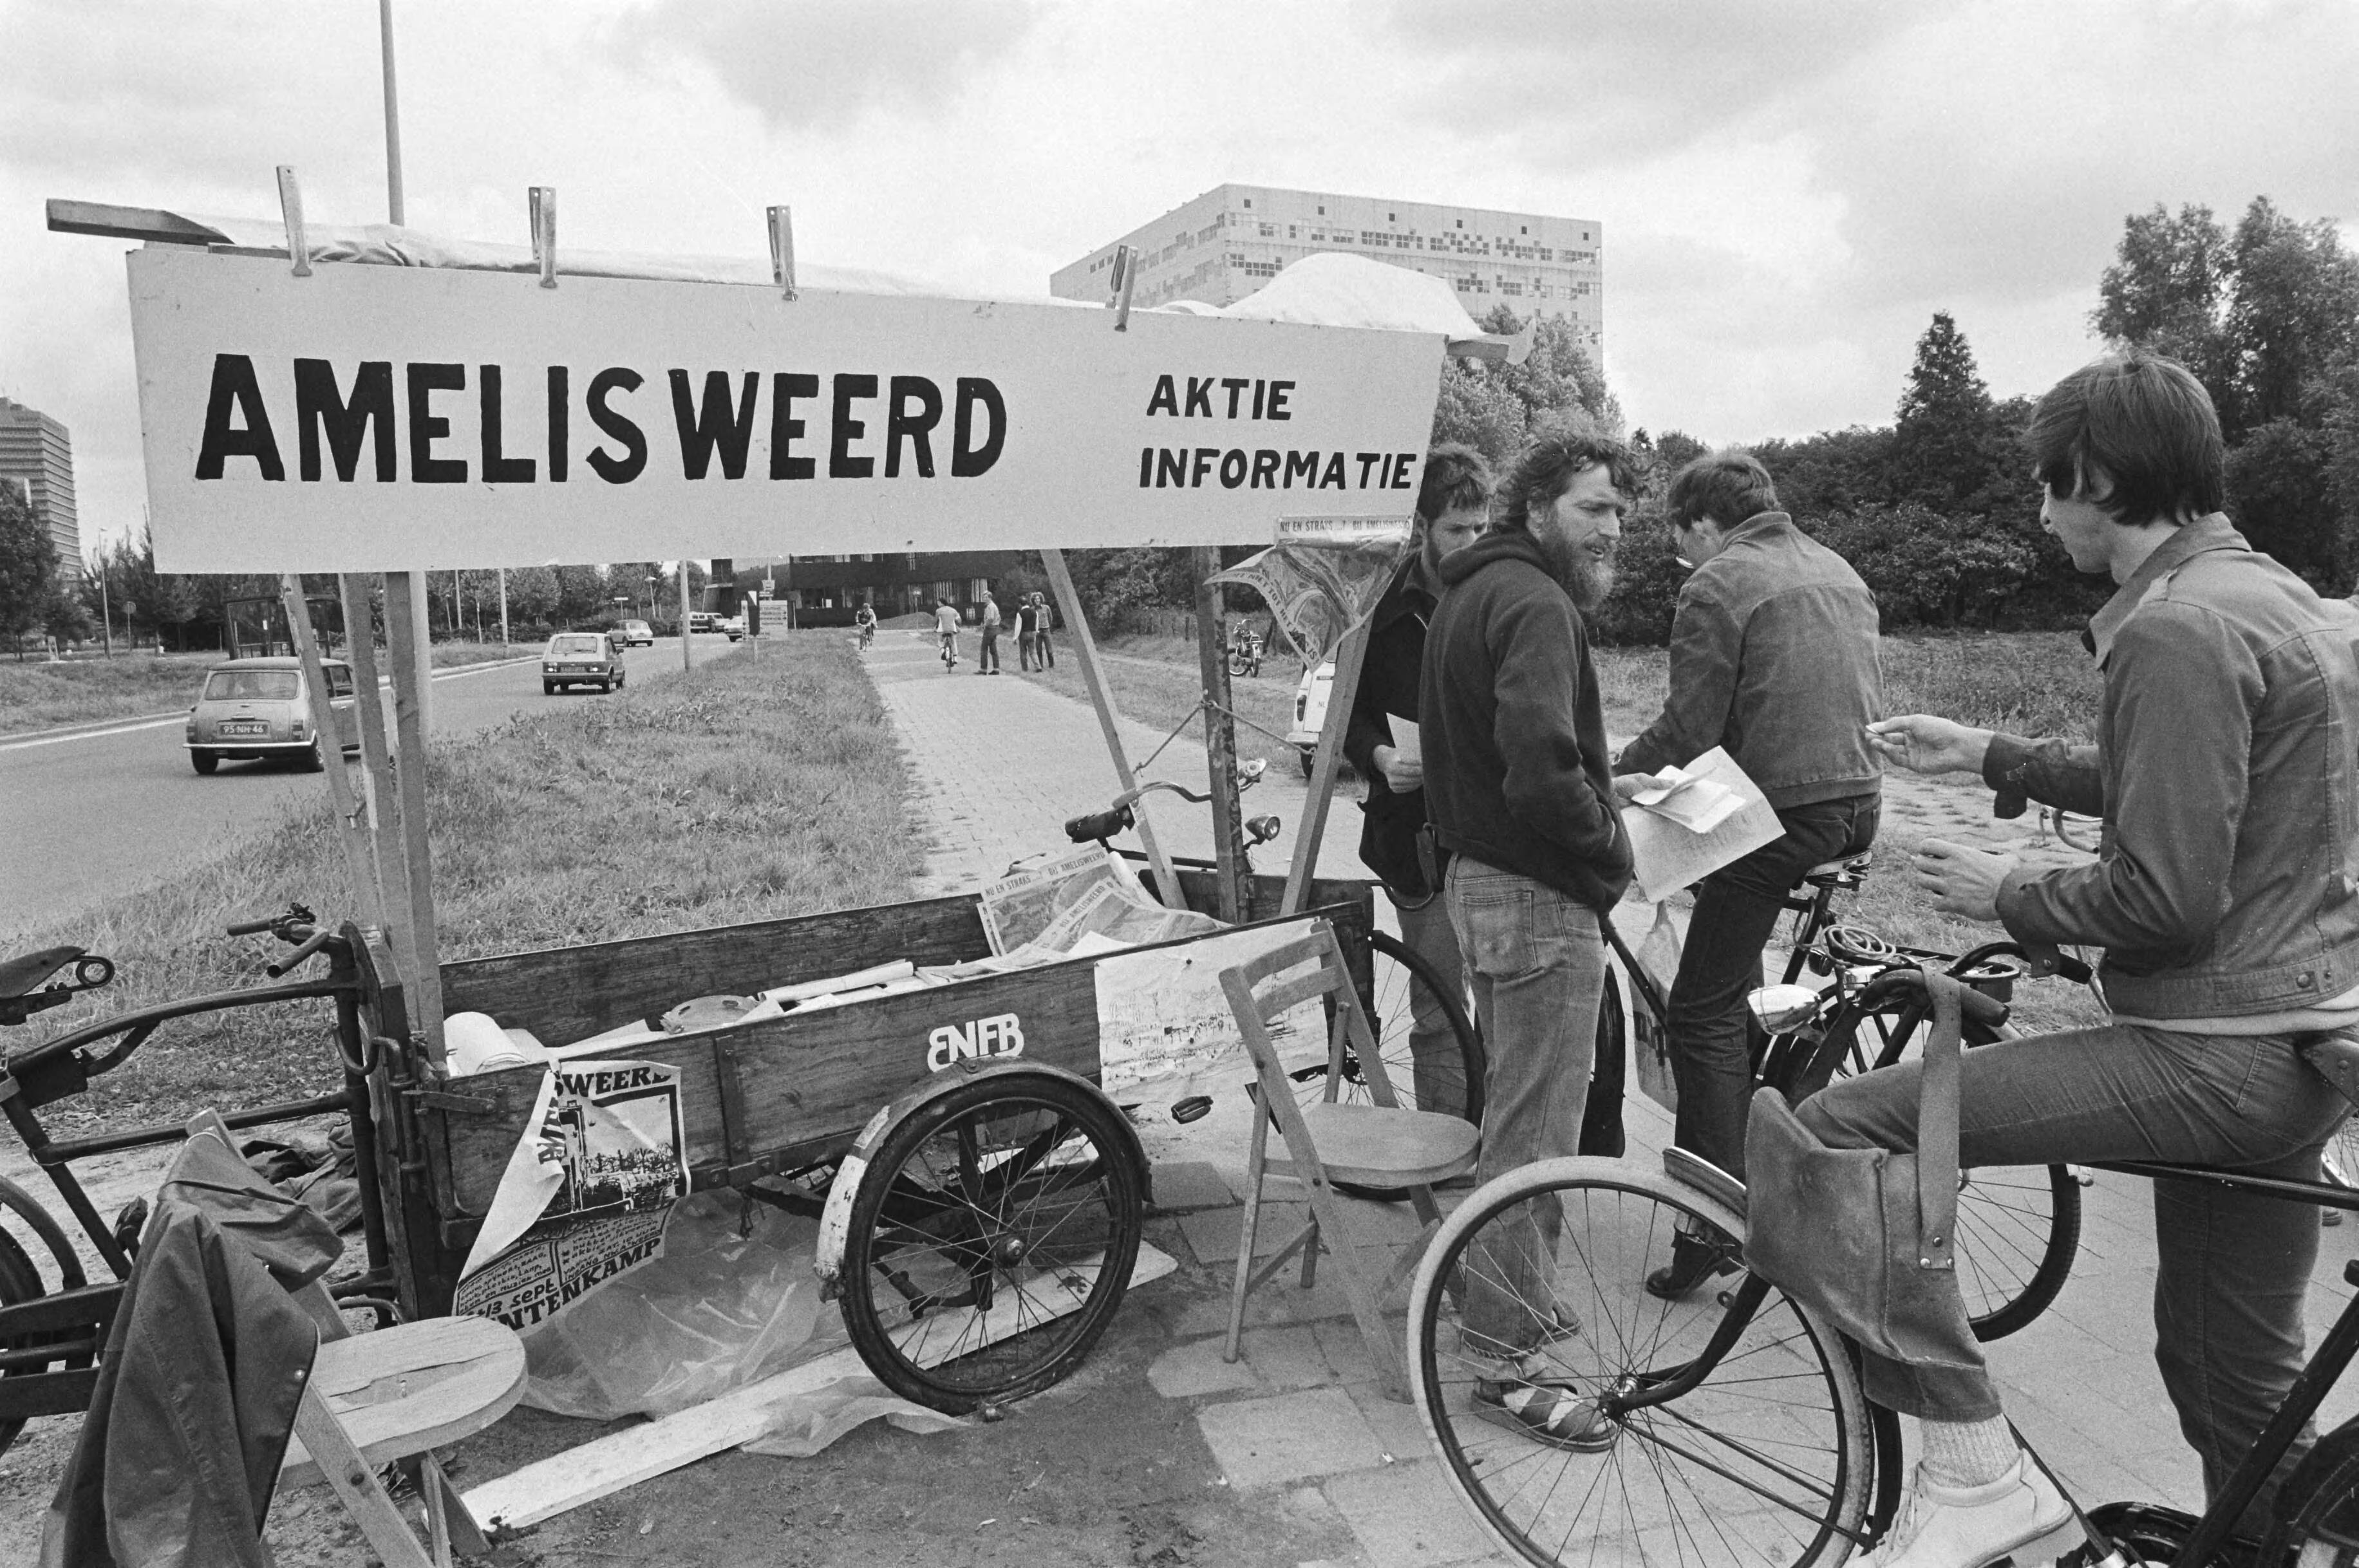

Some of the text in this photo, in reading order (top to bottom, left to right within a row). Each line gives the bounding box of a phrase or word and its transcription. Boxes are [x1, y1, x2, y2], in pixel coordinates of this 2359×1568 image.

[195, 354, 1006, 484] AMELISWEERD
[1147, 375, 1295, 420] AKTIE
[1140, 448, 1416, 490] INFORMATIE
[1293, 520, 1302, 532] EN
[996, 884, 1005, 893] EN
[1006, 875, 1031, 890] STRAKS
[928, 1013, 1024, 1072] ENFB
[491, 1237, 661, 1331] NTENKAMP
[510, 1278, 558, 1309] sept
